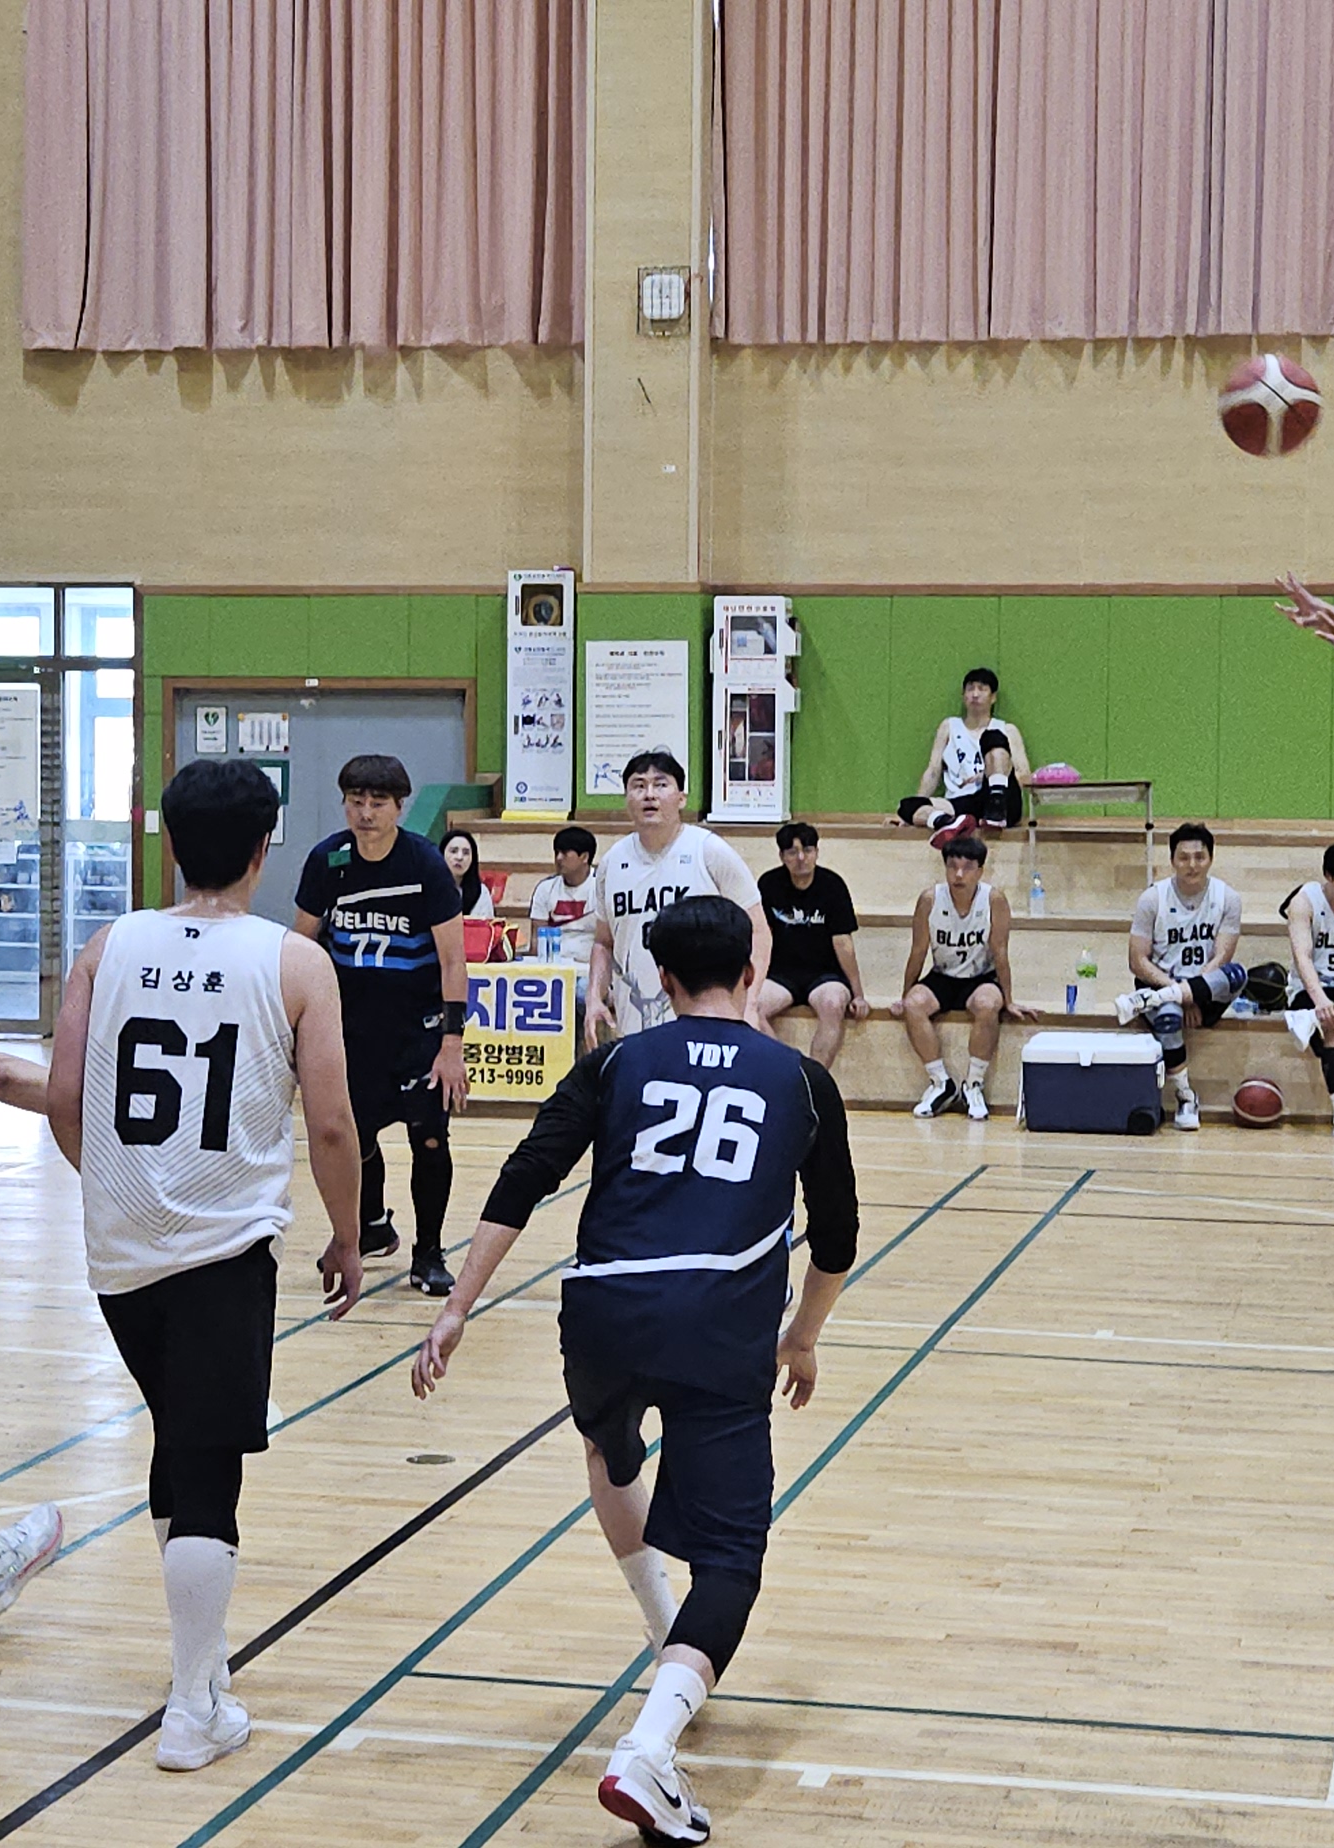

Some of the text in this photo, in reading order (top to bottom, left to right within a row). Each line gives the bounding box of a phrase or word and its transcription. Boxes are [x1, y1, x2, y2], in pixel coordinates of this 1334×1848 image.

[613, 885, 690, 918] BLACK
[334, 910, 410, 935] BELIEVE
[1167, 922, 1215, 945] BLACK
[349, 933, 390, 967] 77
[936, 928, 985, 947] BLACK
[1181, 945, 1204, 966] 89
[463, 1043, 545, 1066] 중앙병원
[686, 1041, 739, 1068] YDY
[114, 1016, 240, 1152] 61
[630, 1080, 767, 1183] 26
